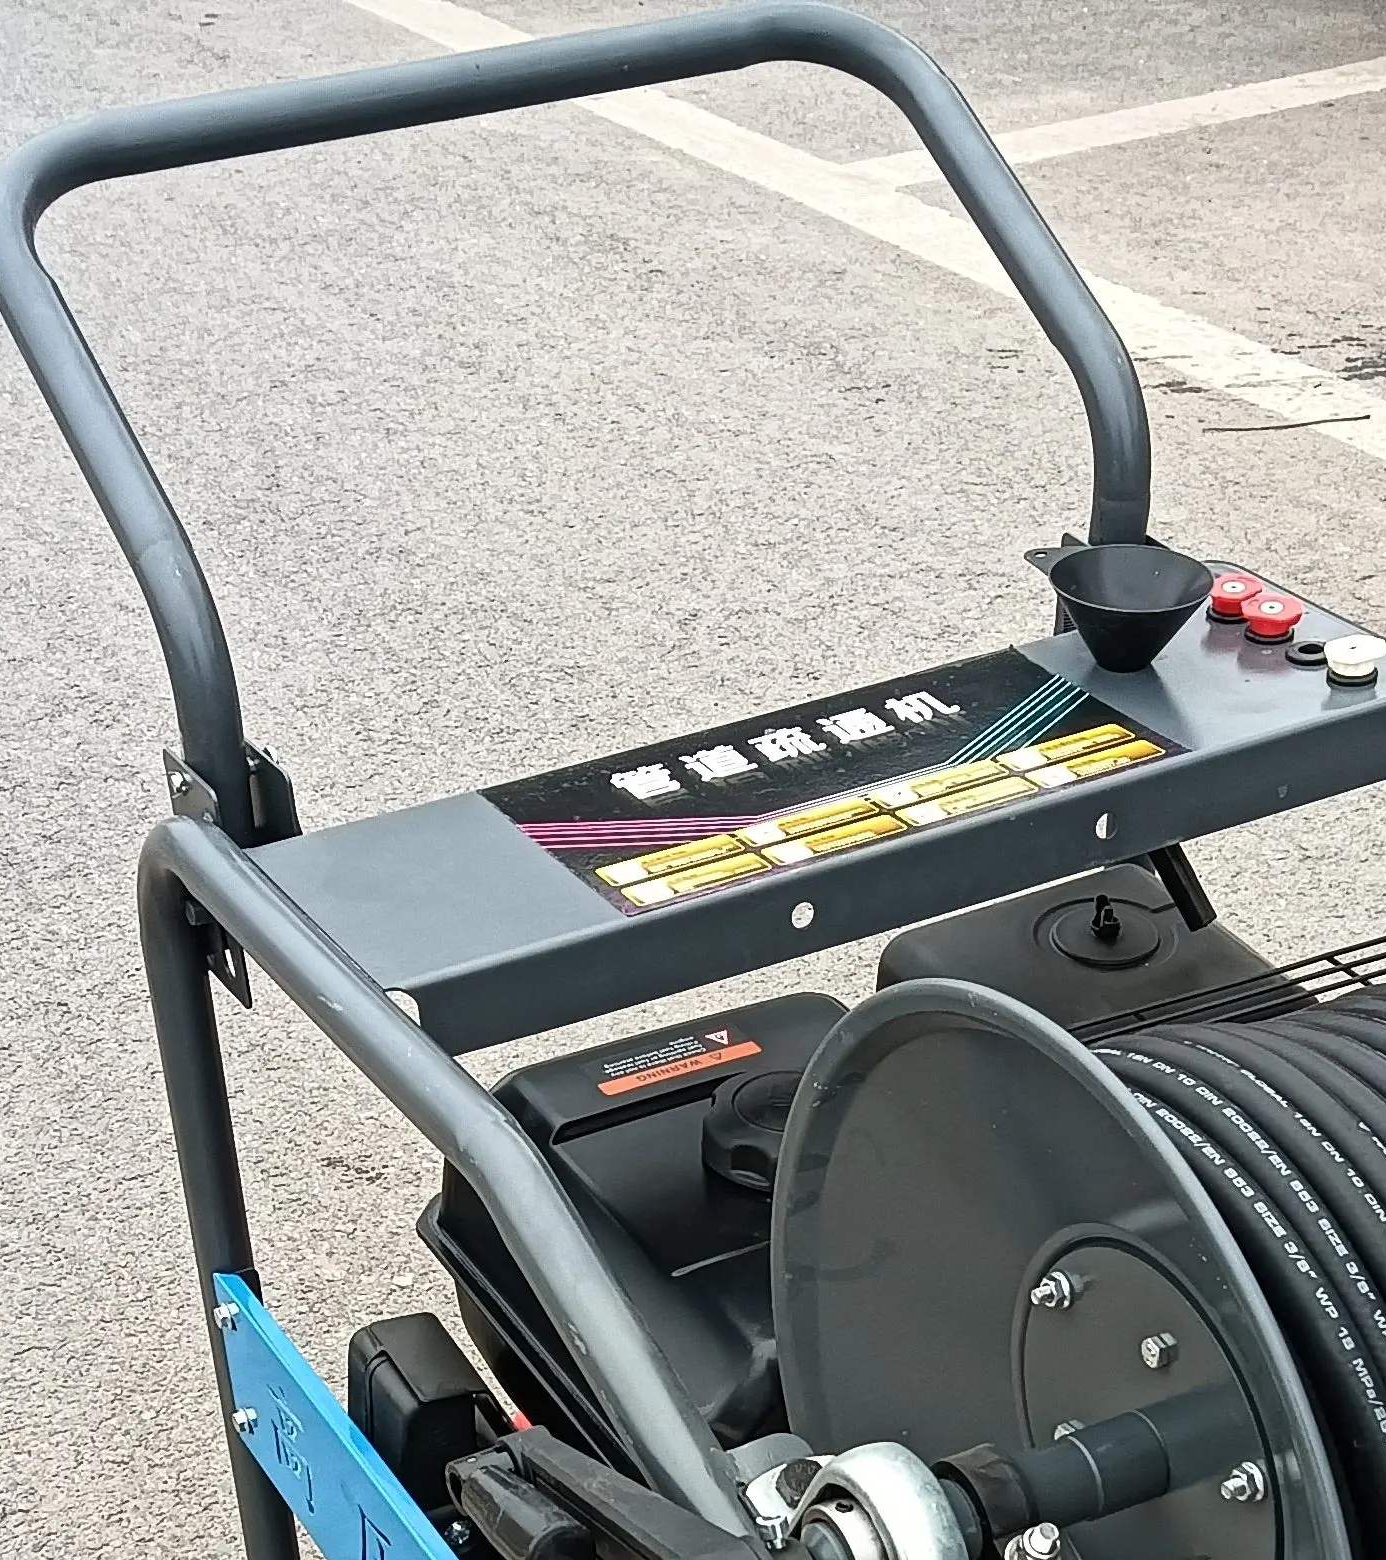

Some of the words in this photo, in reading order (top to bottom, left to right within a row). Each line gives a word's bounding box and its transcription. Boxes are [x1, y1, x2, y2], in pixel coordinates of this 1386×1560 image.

[610, 690, 961, 800] 管道疏通机
[636, 1060, 702, 1081] WARNING
[1152, 1062, 1176, 1074] DN
[1176, 1073, 1196, 1086] 10
[1195, 1086, 1223, 1106] DIN
[1221, 1107, 1291, 1176] 20022/EN
[1317, 1218, 1349, 1257] SIZE
[1155, 1108, 1226, 1166] 20022/EN
[1253, 1201, 1287, 1238] SIZE
[1315, 1286, 1339, 1319] WP
[1321, 1141, 1345, 1163] DN
[1346, 1168, 1365, 1188] 10
